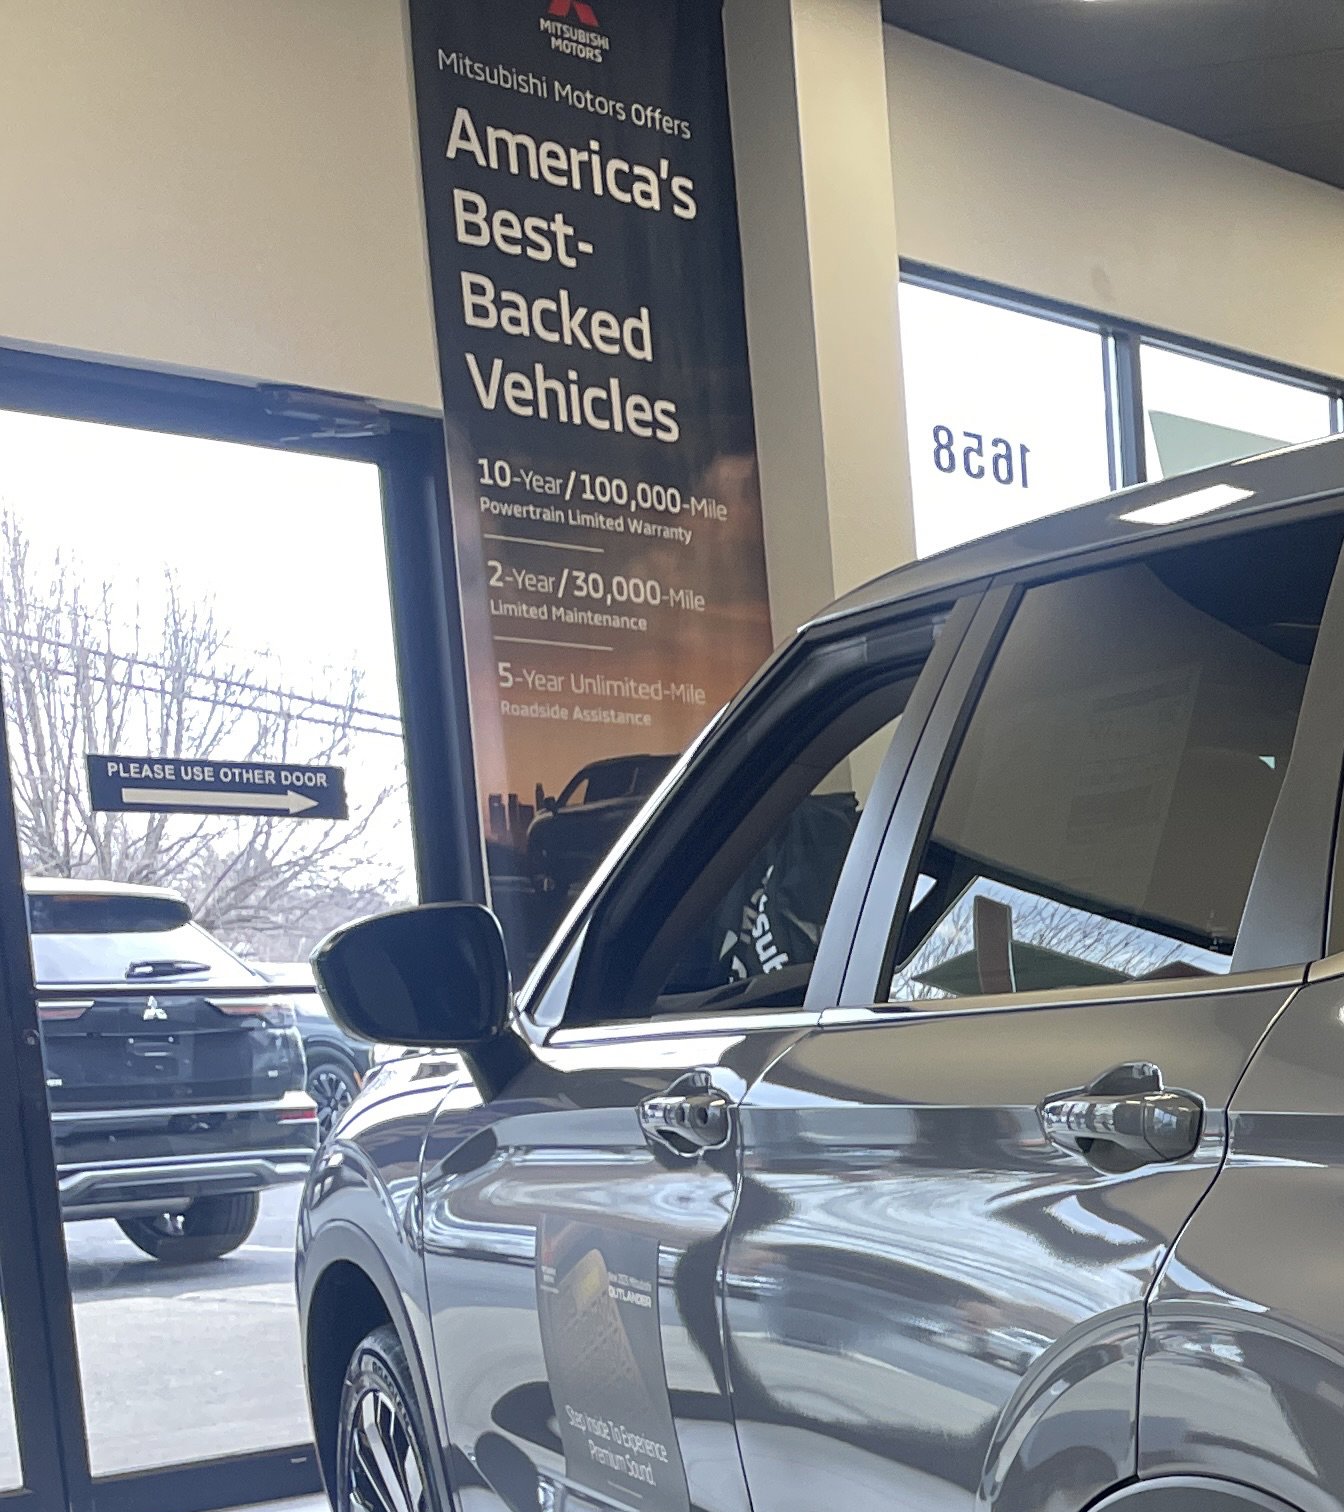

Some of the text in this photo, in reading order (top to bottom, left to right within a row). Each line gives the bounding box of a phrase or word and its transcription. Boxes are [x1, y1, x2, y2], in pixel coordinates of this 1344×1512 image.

[539, 18, 610, 50] MITSUBISHI
[550, 36, 603, 62] MOTORS
[437, 49, 691, 140] Mitsubishi Motors Offers
[445, 106, 698, 220] America's
[453, 188, 594, 268] Best-
[460, 270, 654, 362] Backed
[464, 352, 680, 443] Vehicles
[480, 496, 692, 545] Powertrain Limited Warranty
[490, 599, 648, 631] Limited Maintenance
[497, 661, 706, 706] 5-Year Unlimited-Mile
[501, 700, 652, 726] Roadside Assistance
[107, 761, 328, 788] PLEASE USE OTHER DOOR
[565, 1404, 587, 1434] Step
[620, 1425, 668, 1463] Experience
[588, 1439, 627, 1474] Premium
